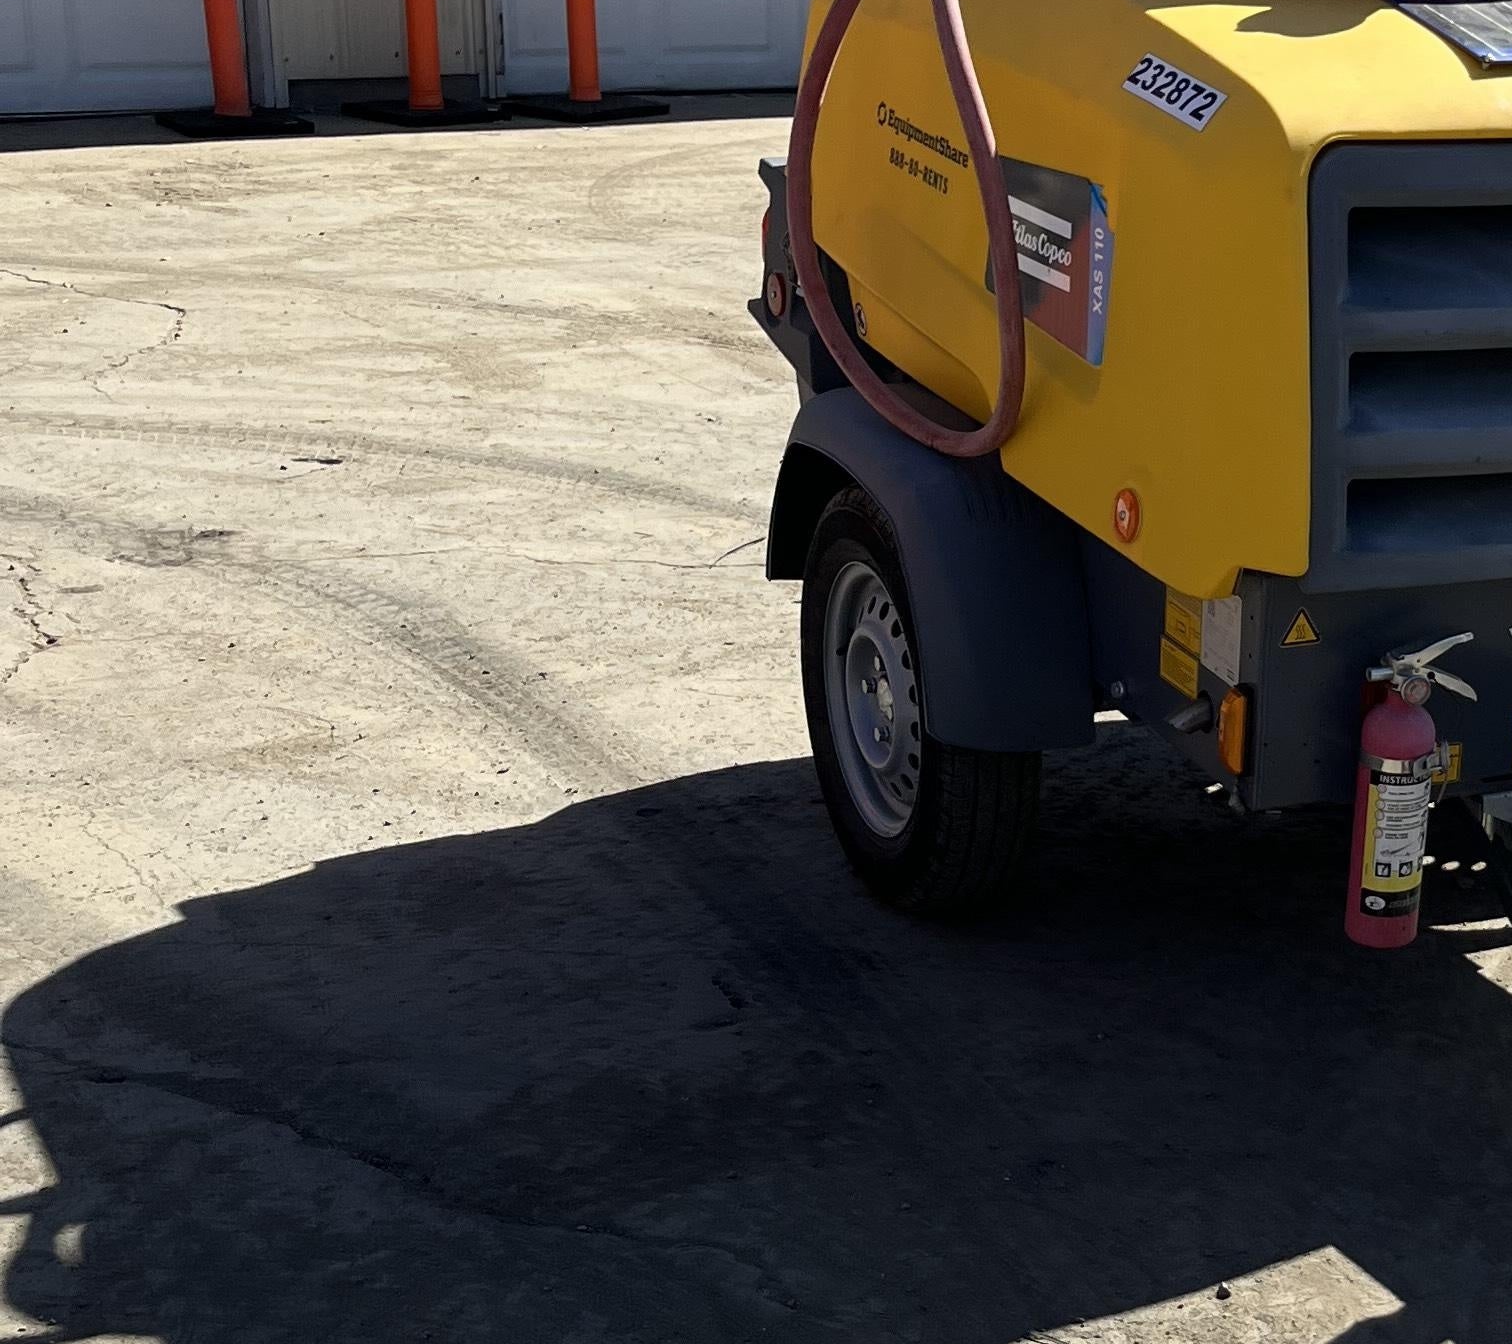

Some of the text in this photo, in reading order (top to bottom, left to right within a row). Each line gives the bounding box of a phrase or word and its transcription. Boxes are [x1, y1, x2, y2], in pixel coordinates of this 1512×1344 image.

[1126, 57, 1218, 122] 232872
[888, 108, 969, 169] EquipmentShare
[1092, 227, 1106, 315] XAS 110
